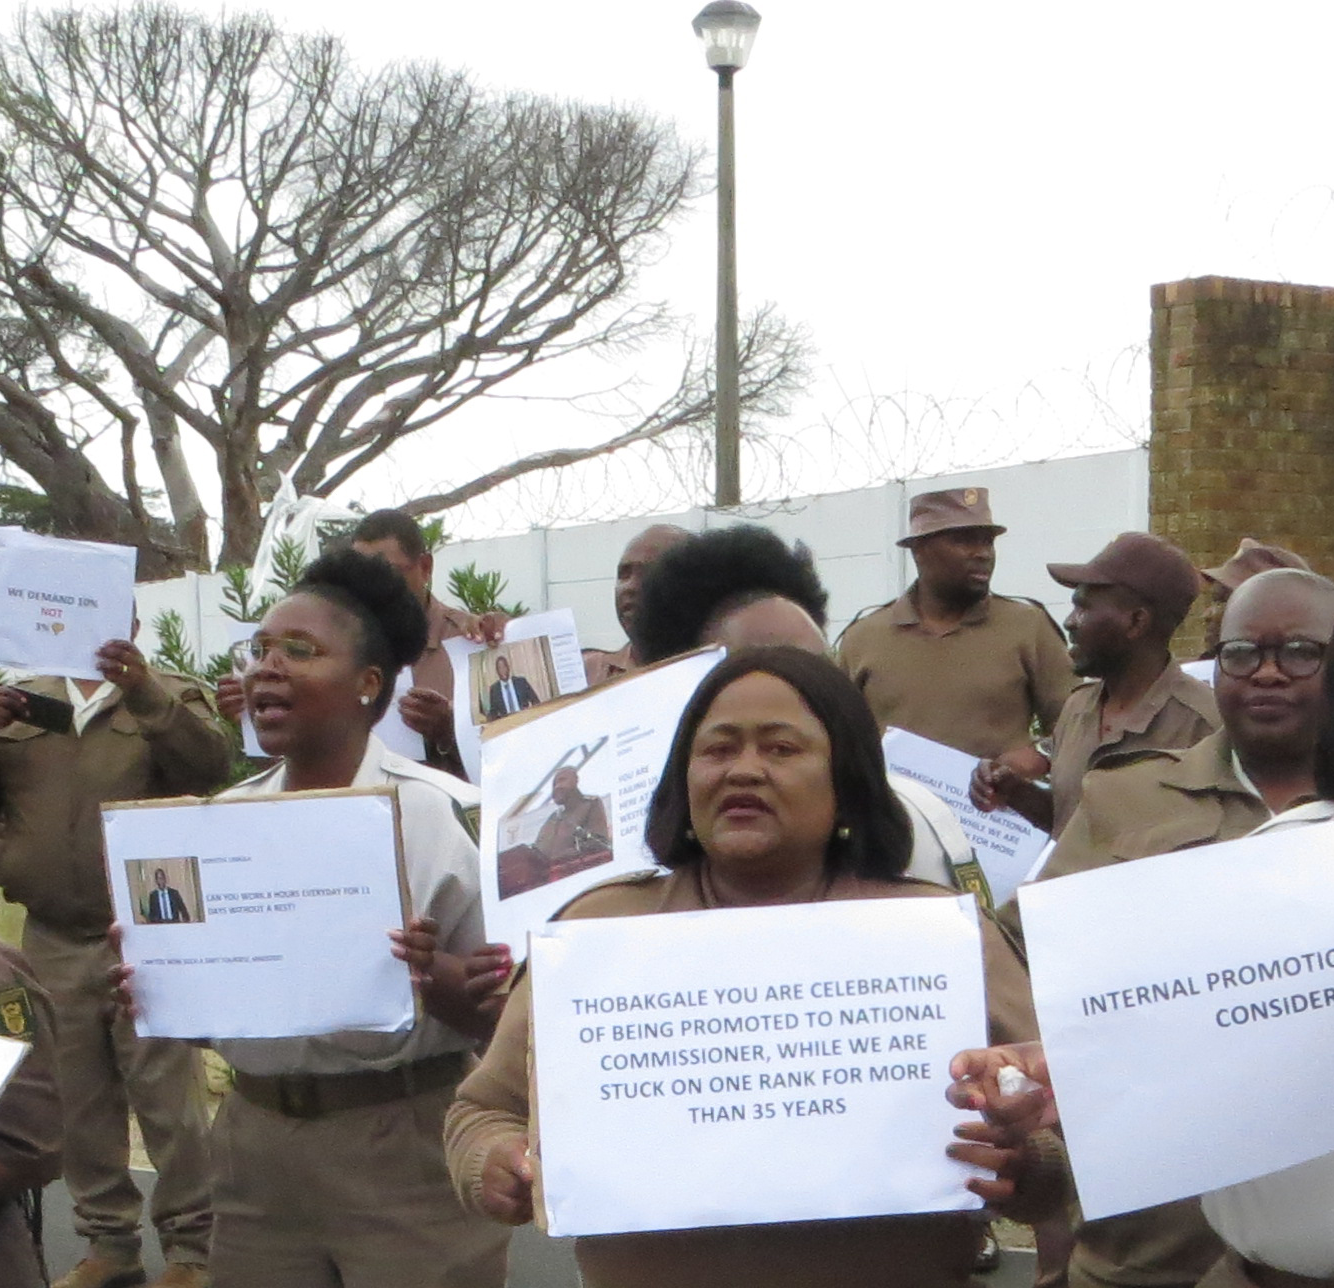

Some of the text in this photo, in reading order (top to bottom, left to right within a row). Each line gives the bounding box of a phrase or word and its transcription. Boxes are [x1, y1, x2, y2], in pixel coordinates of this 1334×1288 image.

[8, 588, 24, 597] WE
[27, 591, 75, 605] DEMAND
[41, 608, 63, 618] NOT
[945, 783, 964, 797] YOU
[241, 892, 264, 900] WORK
[274, 890, 300, 898] HOURS
[302, 888, 342, 897] EVERYDAY
[344, 887, 359, 895] FOR
[208, 906, 228, 916] DAYS
[229, 905, 263, 914] WITHOUT
[572, 974, 948, 1015] THOBAKGALE YOU ARE CELEBRATING
[1081, 977, 1200, 1017] INTERNAL
[579, 1004, 945, 1044] OF BEING PROMOTED TO NATIONAL
[600, 1034, 927, 1071] COMMISSIONER, WHILE WE ARE
[600, 1063, 931, 1101] STUCK ON ONE RANK FOR MORE
[689, 1098, 846, 1124] THAN 35 YEARS
